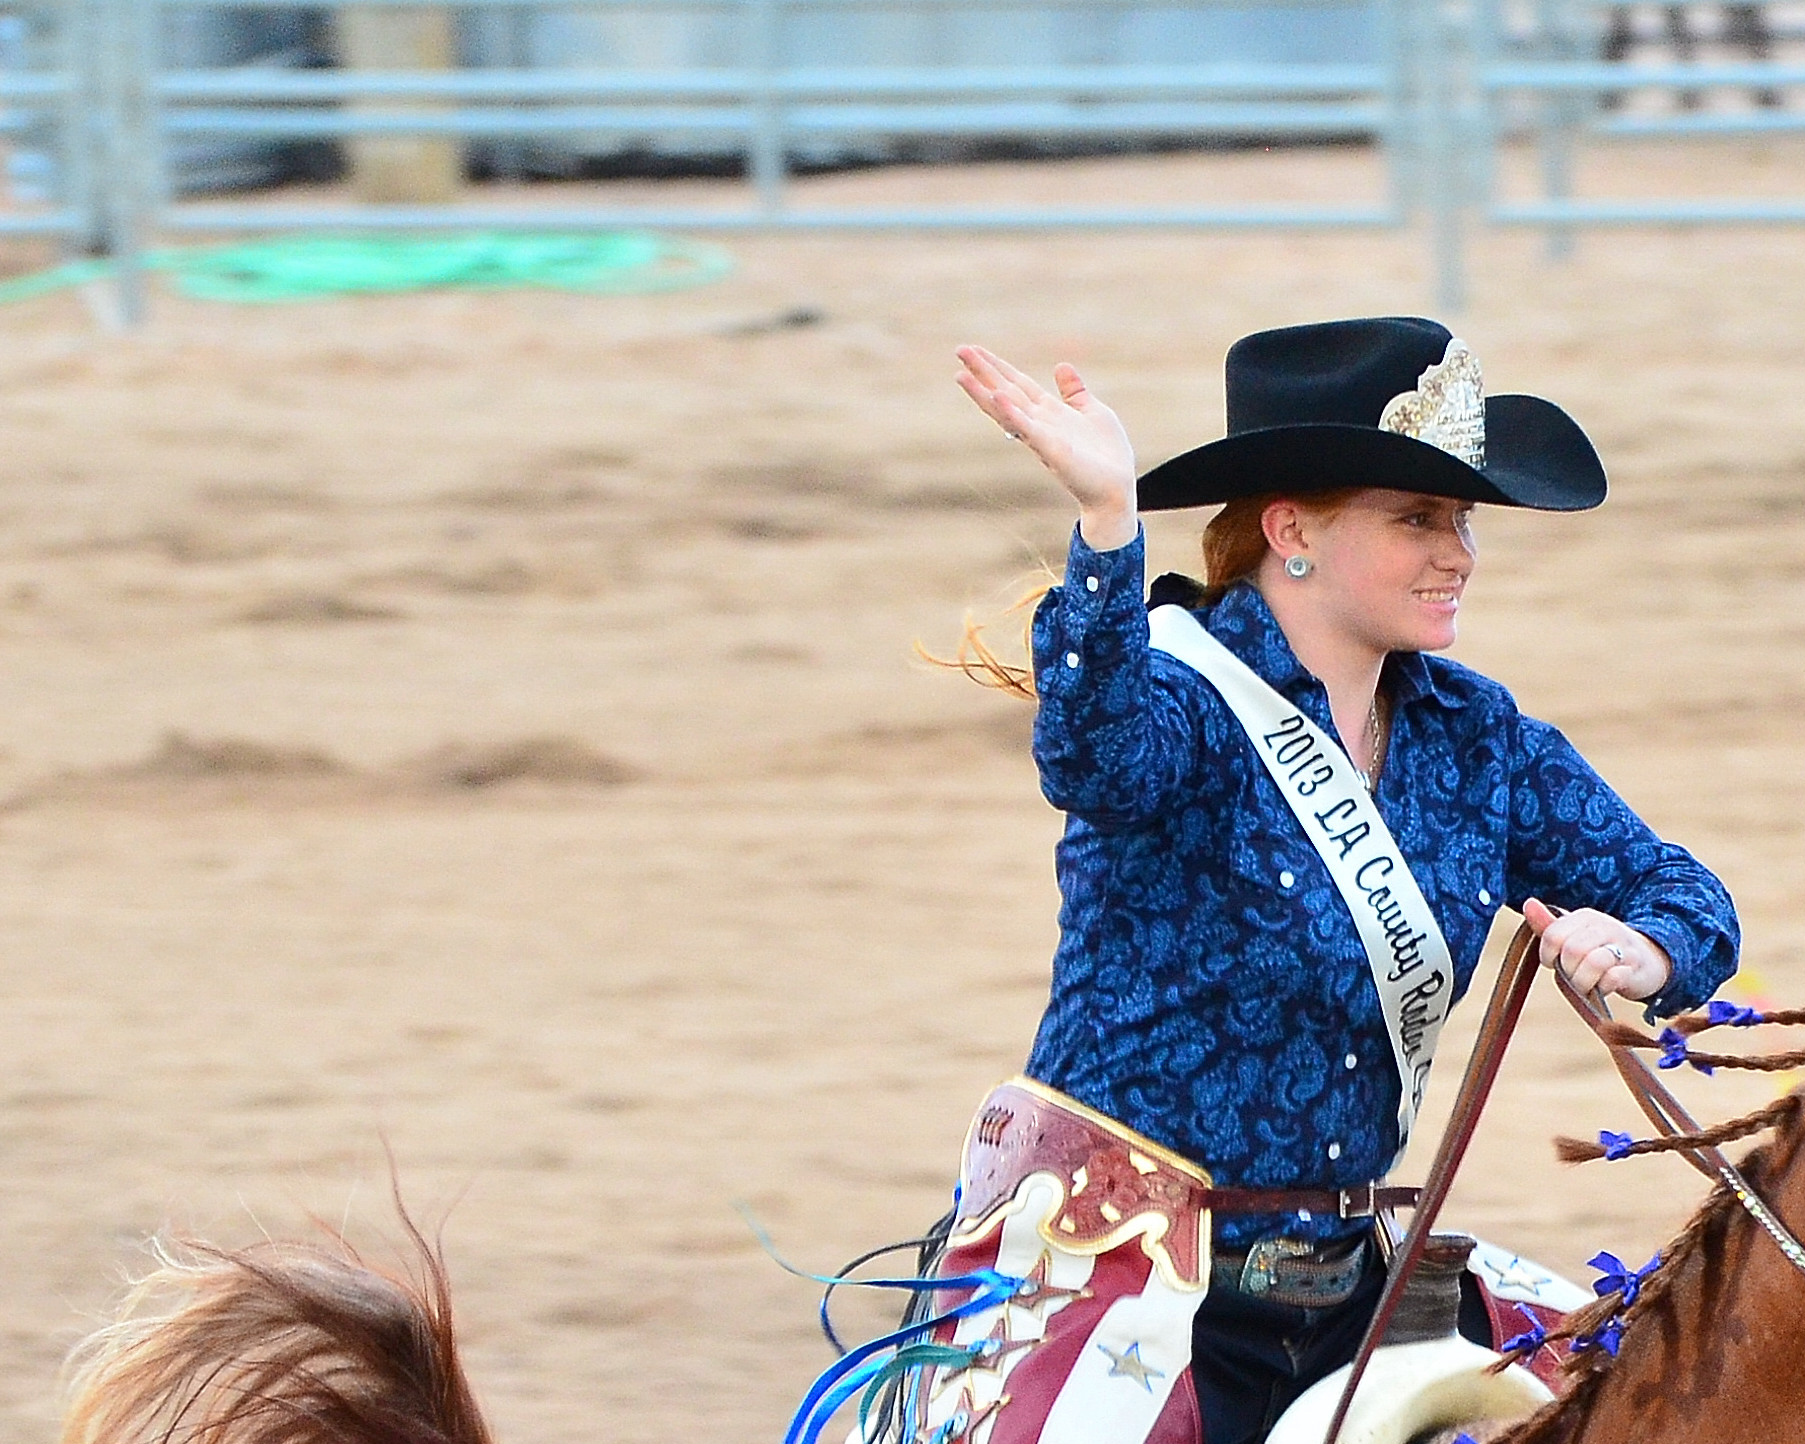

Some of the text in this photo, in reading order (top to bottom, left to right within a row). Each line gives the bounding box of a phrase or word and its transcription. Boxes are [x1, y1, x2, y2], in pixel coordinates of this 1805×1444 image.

[1263, 715, 1334, 796] 2013
[1314, 798, 1370, 860] LA
[1355, 856, 1427, 982] County
